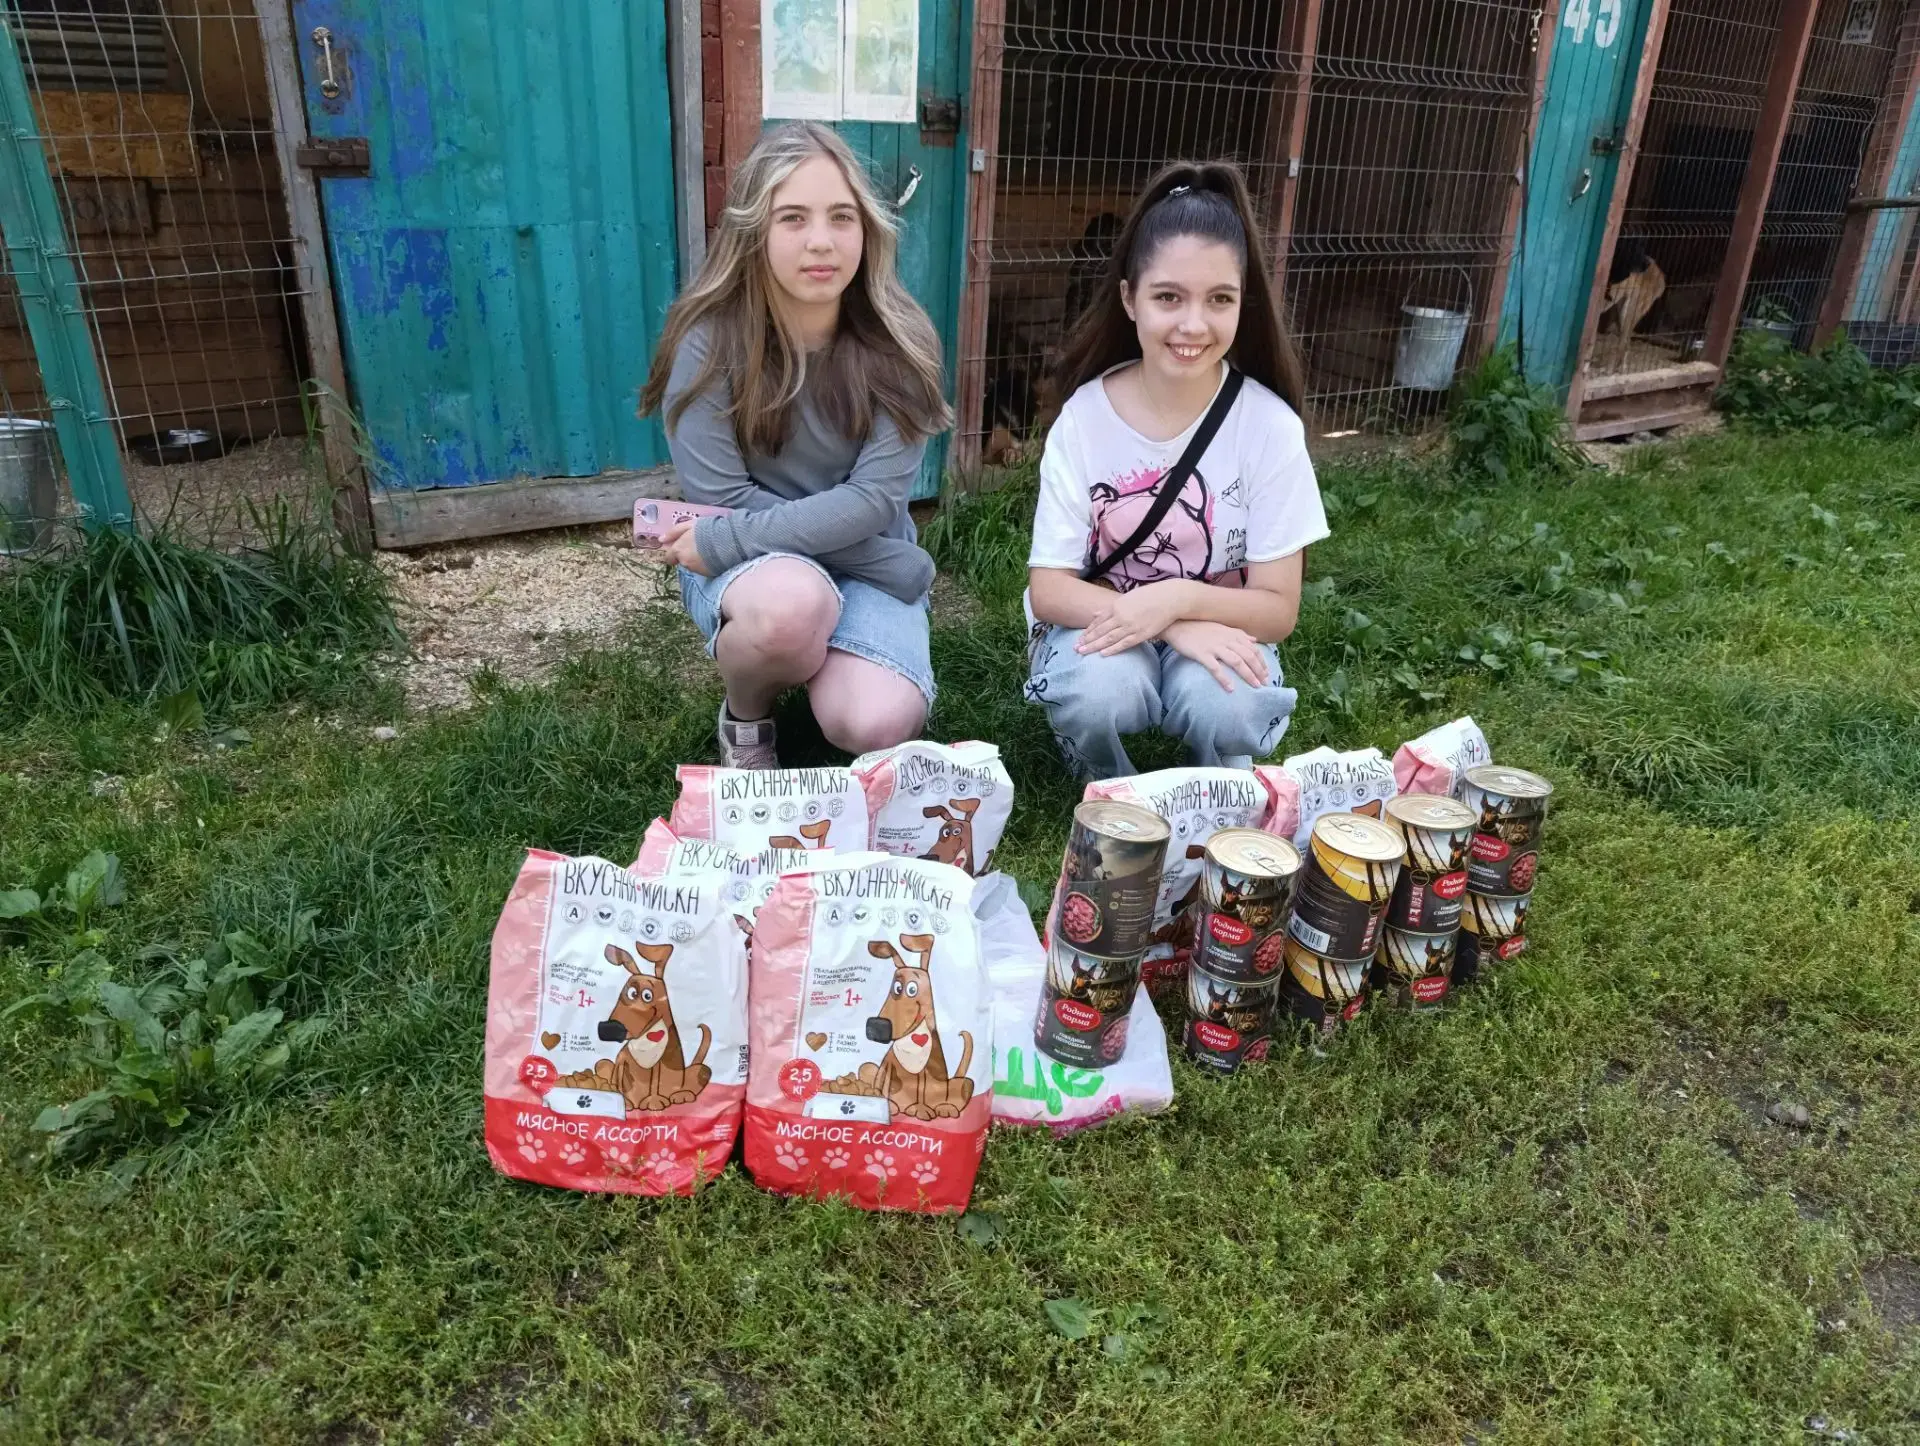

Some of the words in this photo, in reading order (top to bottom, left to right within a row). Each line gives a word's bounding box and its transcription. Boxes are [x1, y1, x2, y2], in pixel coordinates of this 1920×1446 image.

[721, 768, 793, 800] ВКУСНАЯ
[800, 768, 849, 795] МИСКА
[1150, 780, 1203, 818] ВКУСНАЯ
[1209, 780, 1256, 808] МИСКА
[1472, 846, 1499, 858] корма
[1473, 837, 1502, 851] Родные
[564, 862, 637, 904] ВКУСНАЯ
[641, 882, 700, 915] МИСКА
[823, 867, 899, 899] ВКУСНАЯ
[903, 867, 953, 911] МИСКА
[1213, 918, 1245, 934] Родные
[1214, 927, 1241, 941] корма
[578, 989, 595, 1008] 1+
[844, 988, 863, 1006] 1+
[1061, 1003, 1094, 1019] Родные
[1062, 1013, 1090, 1027] корма
[1201, 1025, 1232, 1040] Родные
[1202, 1034, 1229, 1047] корма
[516, 1112, 590, 1139] МЯСНОЕ
[594, 1125, 678, 1144] АССОРТИ
[776, 1121, 853, 1144] МЯСНОЕ
[859, 1130, 943, 1156] АССОРТИ
